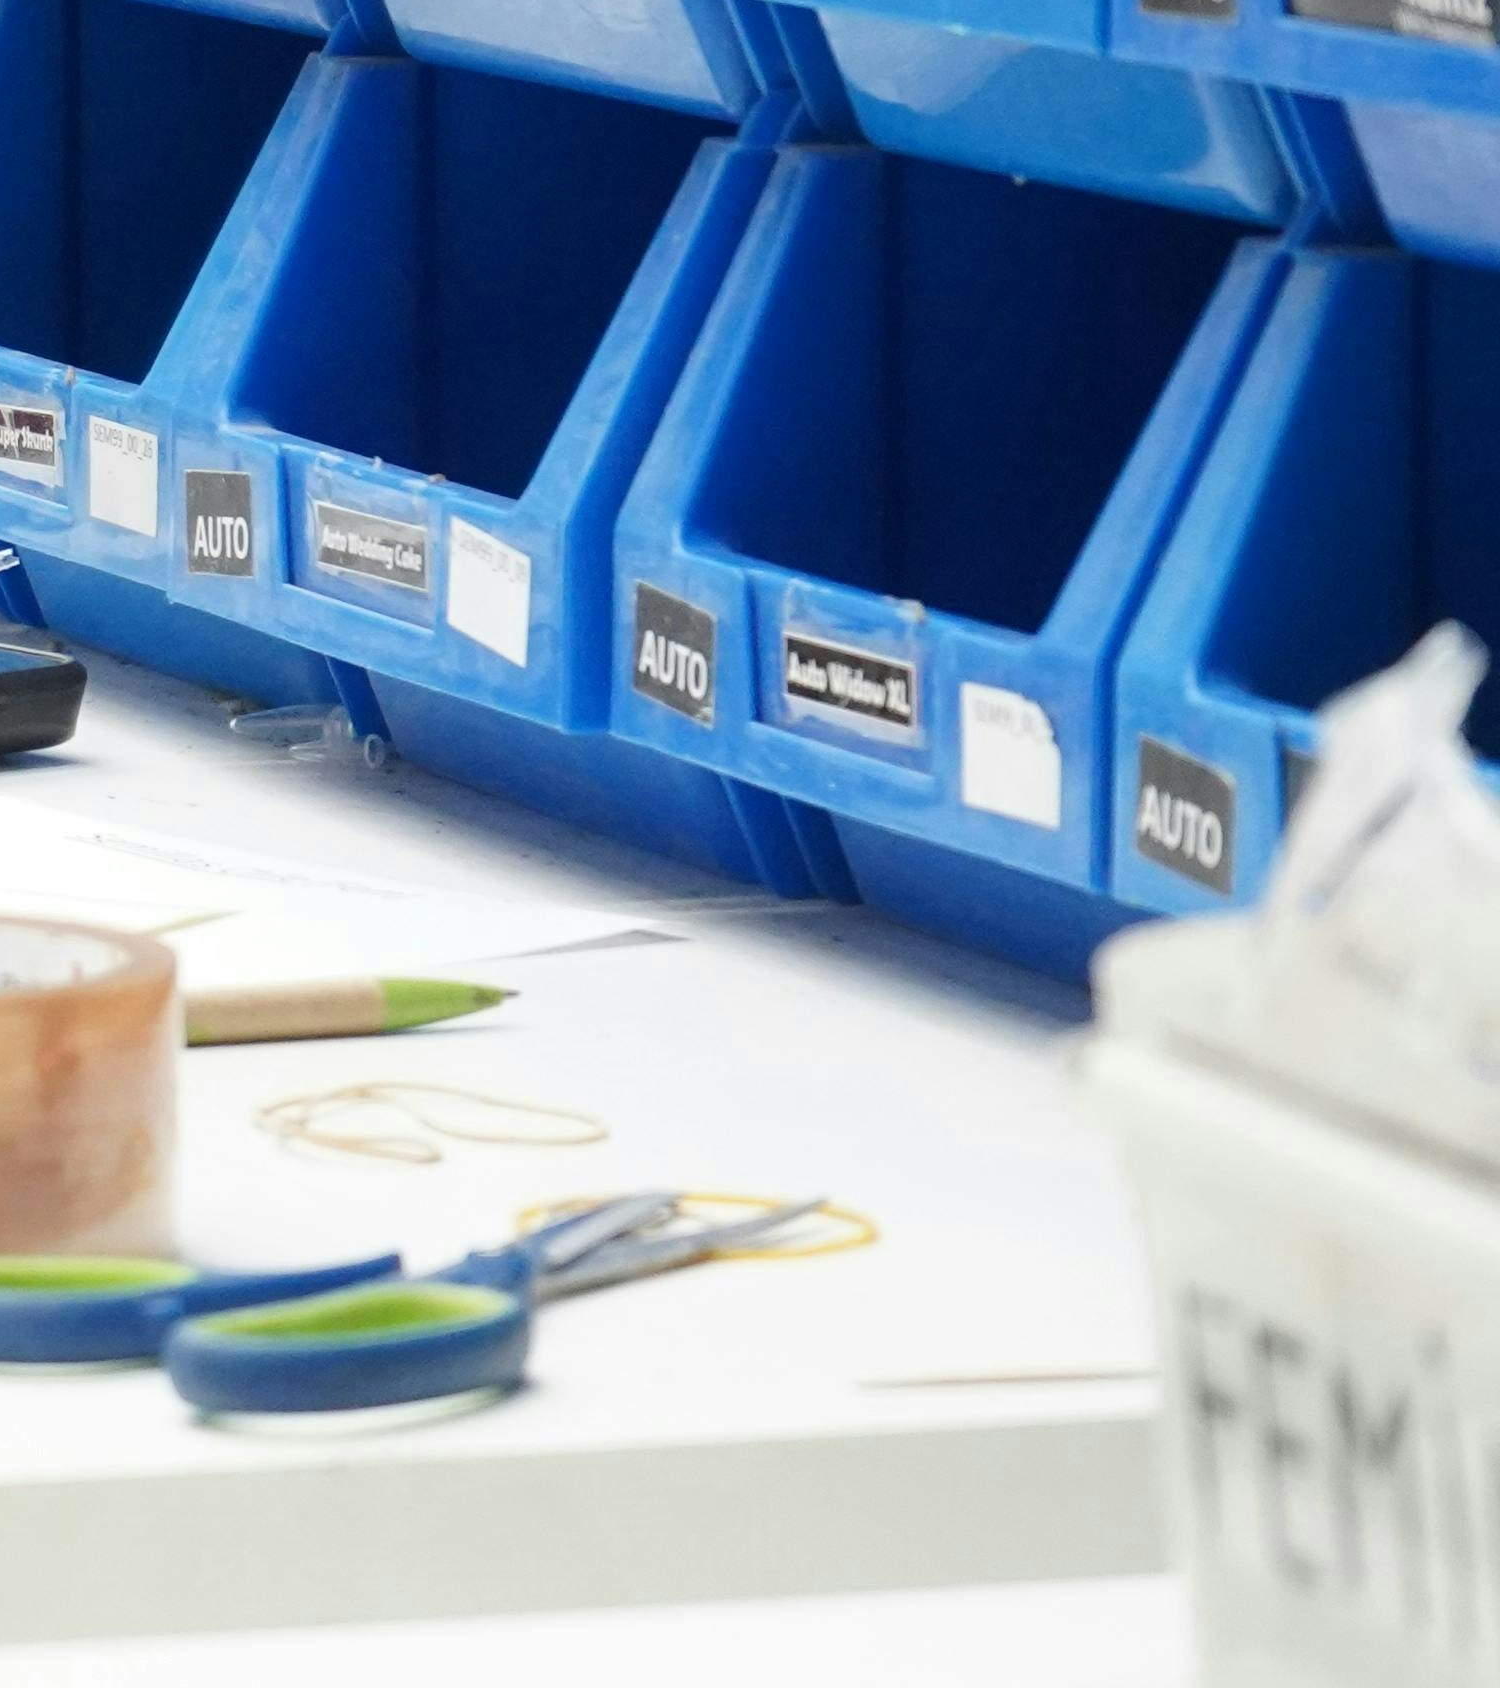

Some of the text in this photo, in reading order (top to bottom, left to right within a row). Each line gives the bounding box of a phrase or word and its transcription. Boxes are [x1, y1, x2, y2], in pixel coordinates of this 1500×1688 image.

[20, 428, 54, 454] Skunk
[194, 514, 248, 561] AUTO
[322, 524, 346, 551] Auto
[347, 531, 393, 570] Wedding
[394, 542, 423, 572] Cake
[639, 630, 708, 699] AUTO
[788, 650, 912, 716] Auto Widow XL
[1137, 784, 1223, 871] AUTO
